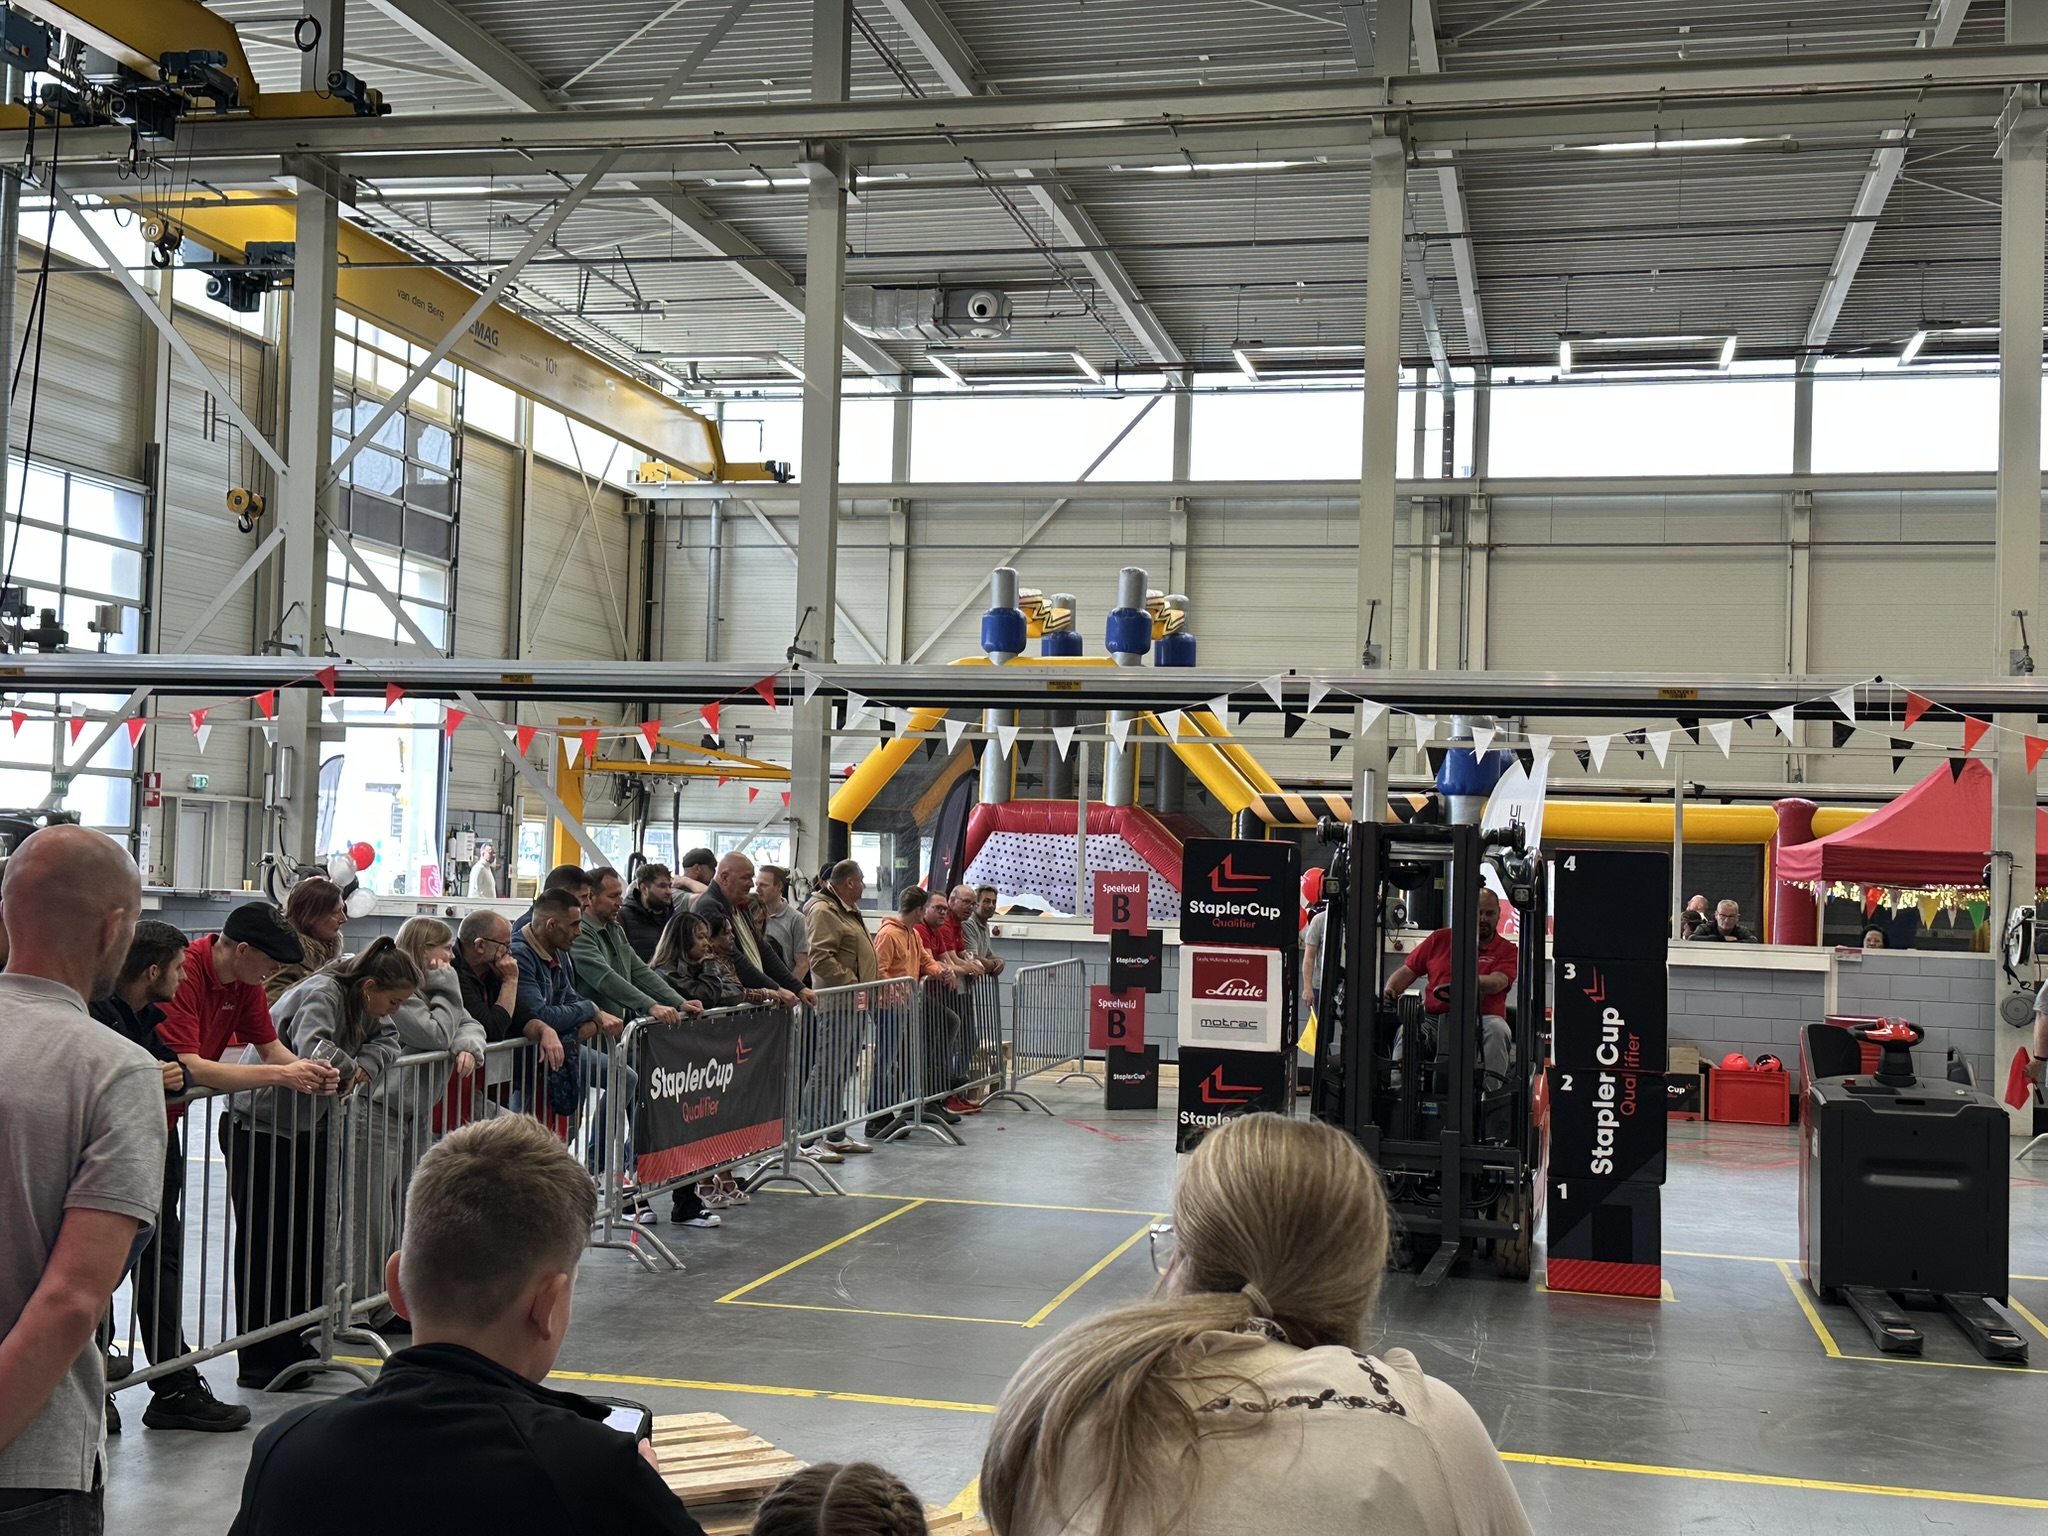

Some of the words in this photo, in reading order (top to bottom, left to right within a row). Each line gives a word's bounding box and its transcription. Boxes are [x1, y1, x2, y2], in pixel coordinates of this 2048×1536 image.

[397, 288, 410, 302] van
[411, 295, 426, 310] den
[427, 302, 445, 321] Berg
[468, 319, 500, 346] EMAG
[545, 356, 558, 377] 10t
[1563, 855, 1577, 871] 4
[1102, 883, 1140, 894] Speelveld
[1112, 894, 1131, 923] B
[1189, 900, 1281, 920] StaplerCup
[1212, 918, 1256, 929] Qualifier
[1563, 963, 1577, 980] 3
[1205, 978, 1263, 997] Linde
[1098, 998, 1137, 1009] Speelveld
[1107, 1009, 1126, 1038] B
[1201, 1018, 1258, 1030] motrac
[650, 1057, 734, 1103] StaplerCup
[1113, 1073, 1146, 1081] StaplerCup
[1560, 1074, 1574, 1091] 2
[1620, 1032, 1640, 1116] Qualifier
[1667, 1085, 1686, 1095] Cup
[682, 1096, 720, 1123] Qualifier
[1557, 1183, 1568, 1199] 1
